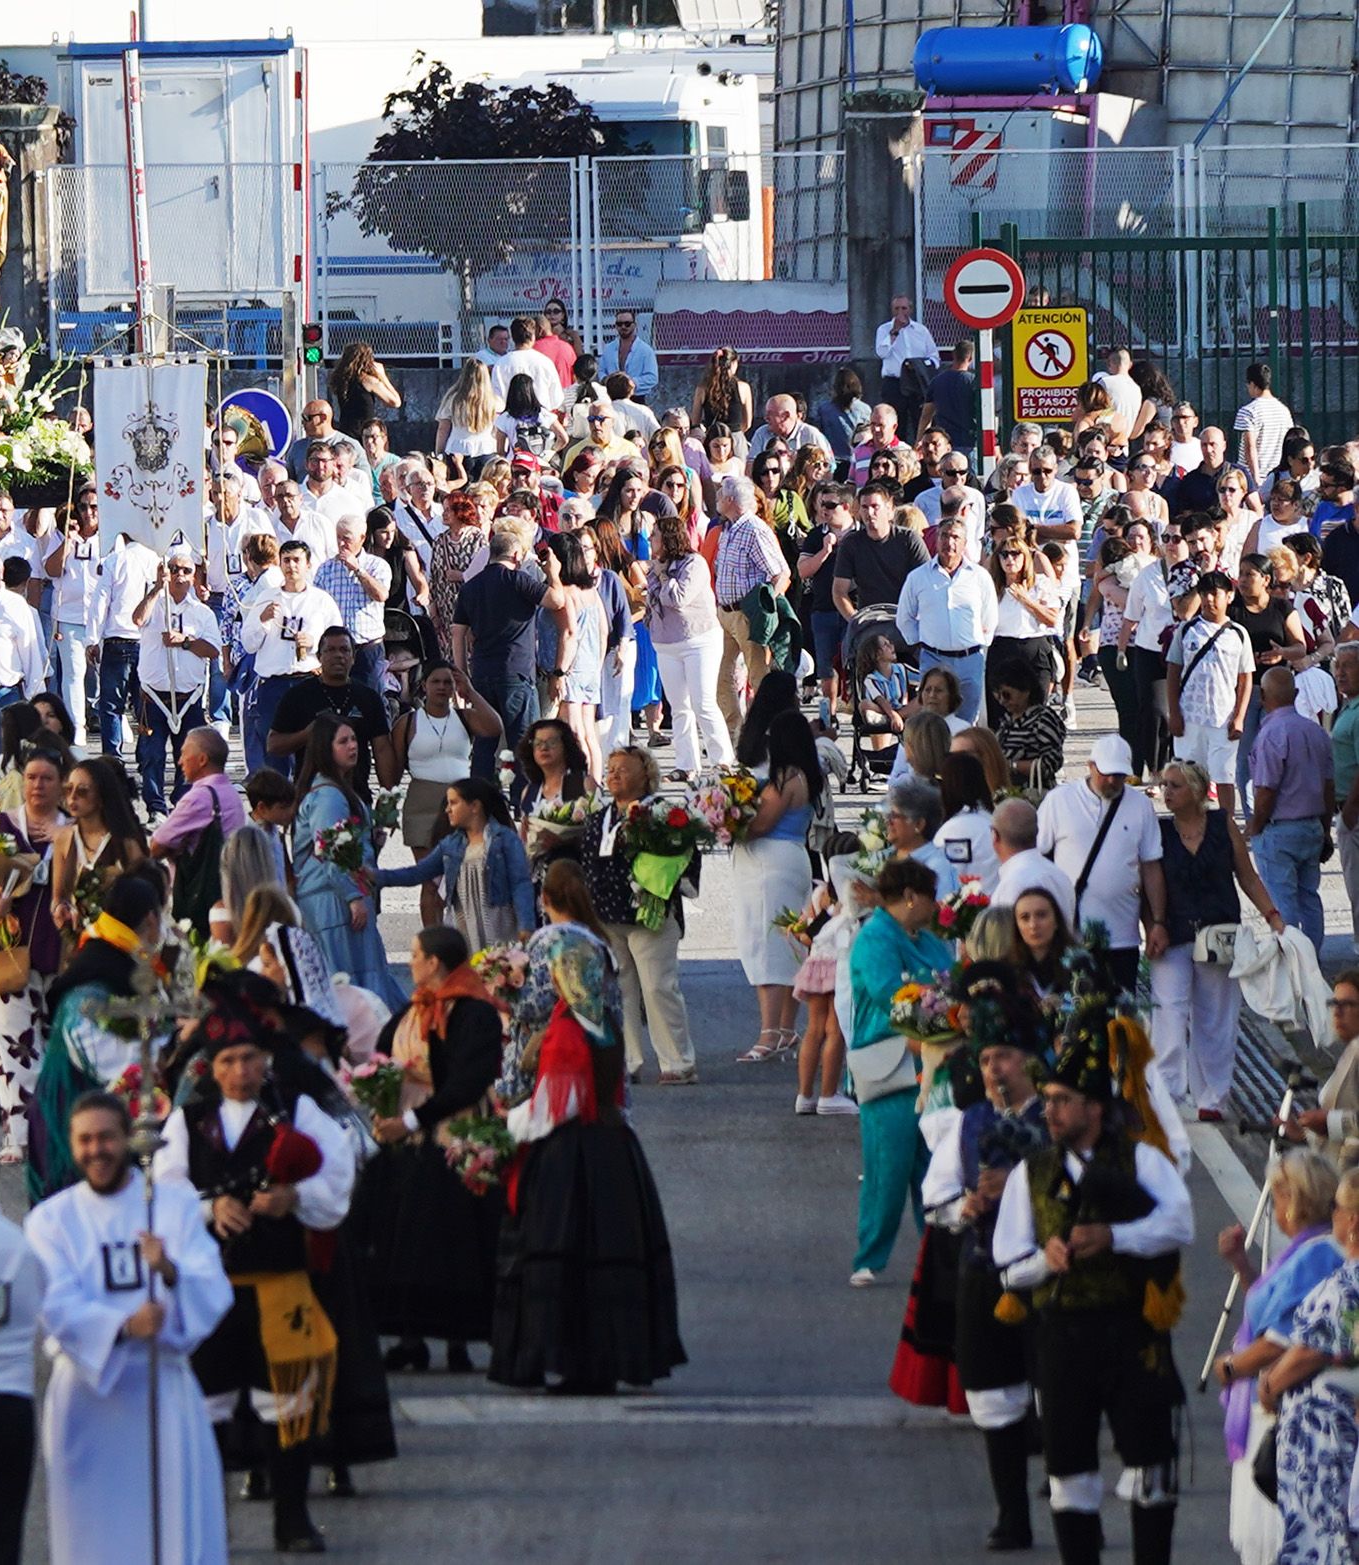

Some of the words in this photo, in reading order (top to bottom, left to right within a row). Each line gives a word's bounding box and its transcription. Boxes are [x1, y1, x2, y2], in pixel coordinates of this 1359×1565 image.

[1018, 312, 1082, 324] ATENCIÓN
[1022, 398, 1037, 407] EL
[1038, 397, 1068, 407] PASO
[1070, 397, 1078, 406] A
